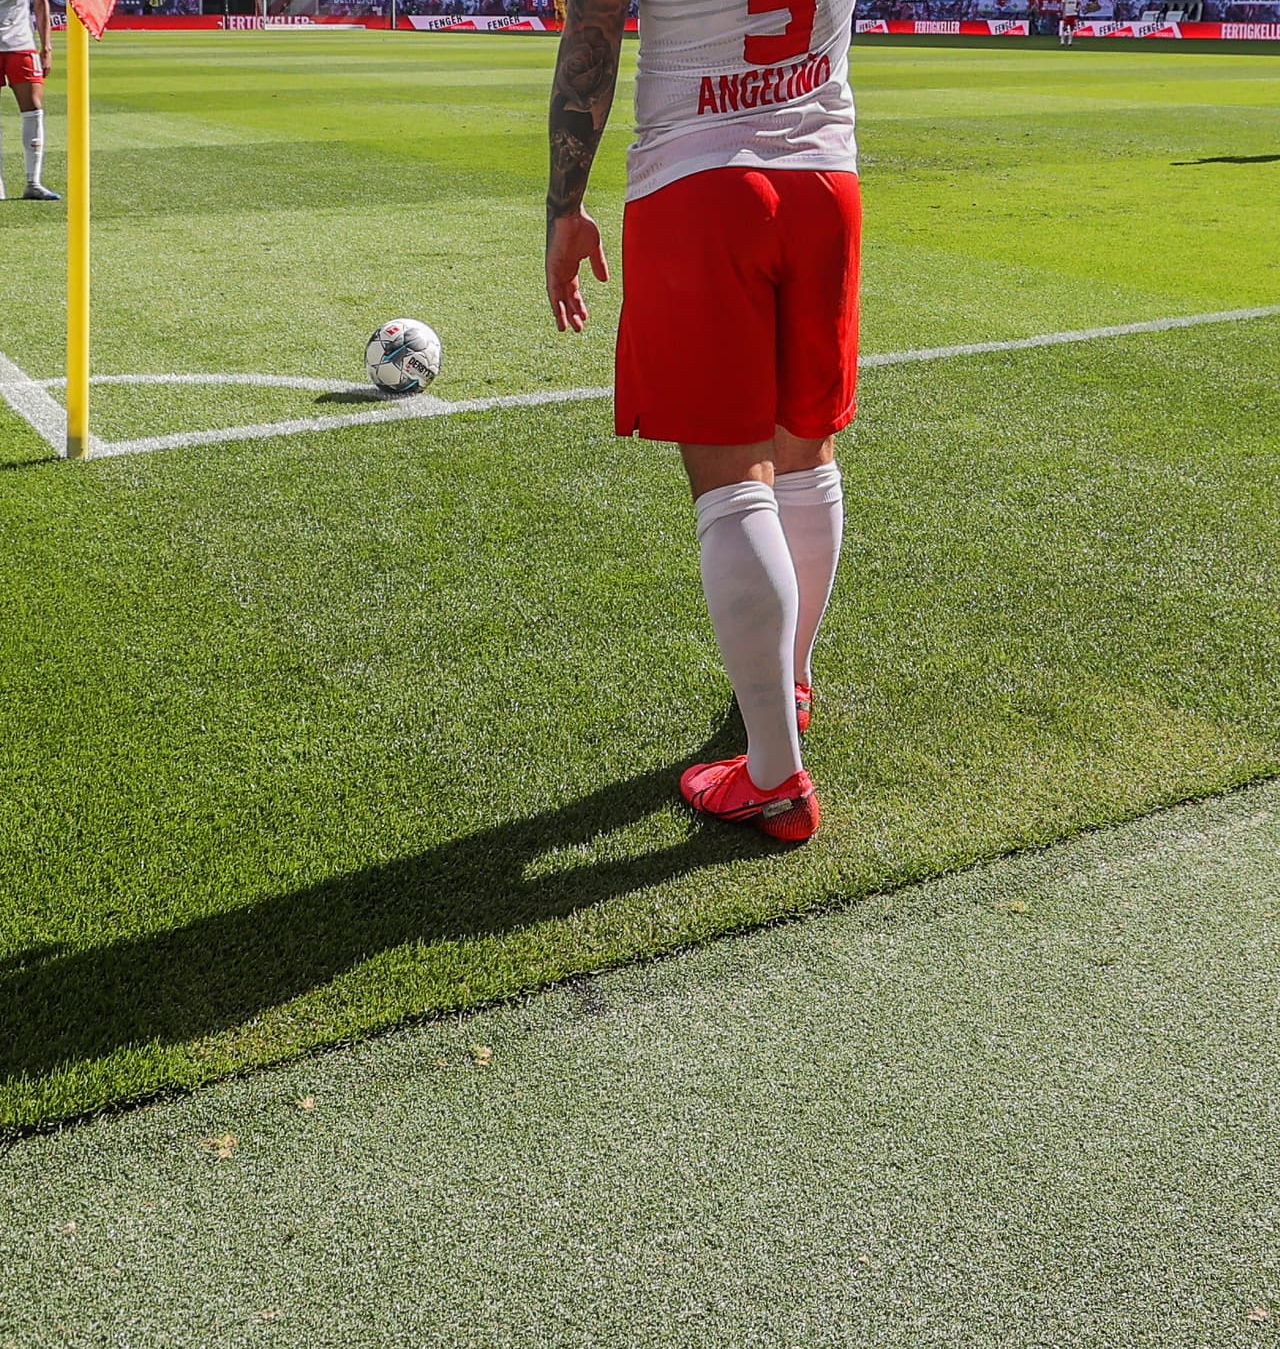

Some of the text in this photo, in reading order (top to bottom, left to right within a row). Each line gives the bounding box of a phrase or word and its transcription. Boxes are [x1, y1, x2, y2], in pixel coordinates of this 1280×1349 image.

[428, 15, 464, 30] FENGER
[487, 15, 521, 31] FENGER
[914, 20, 960, 34] FERTIGKELLER
[994, 20, 1017, 34] FENGER
[1099, 22, 1124, 36] FENGER
[1138, 22, 1165, 37] FENGER
